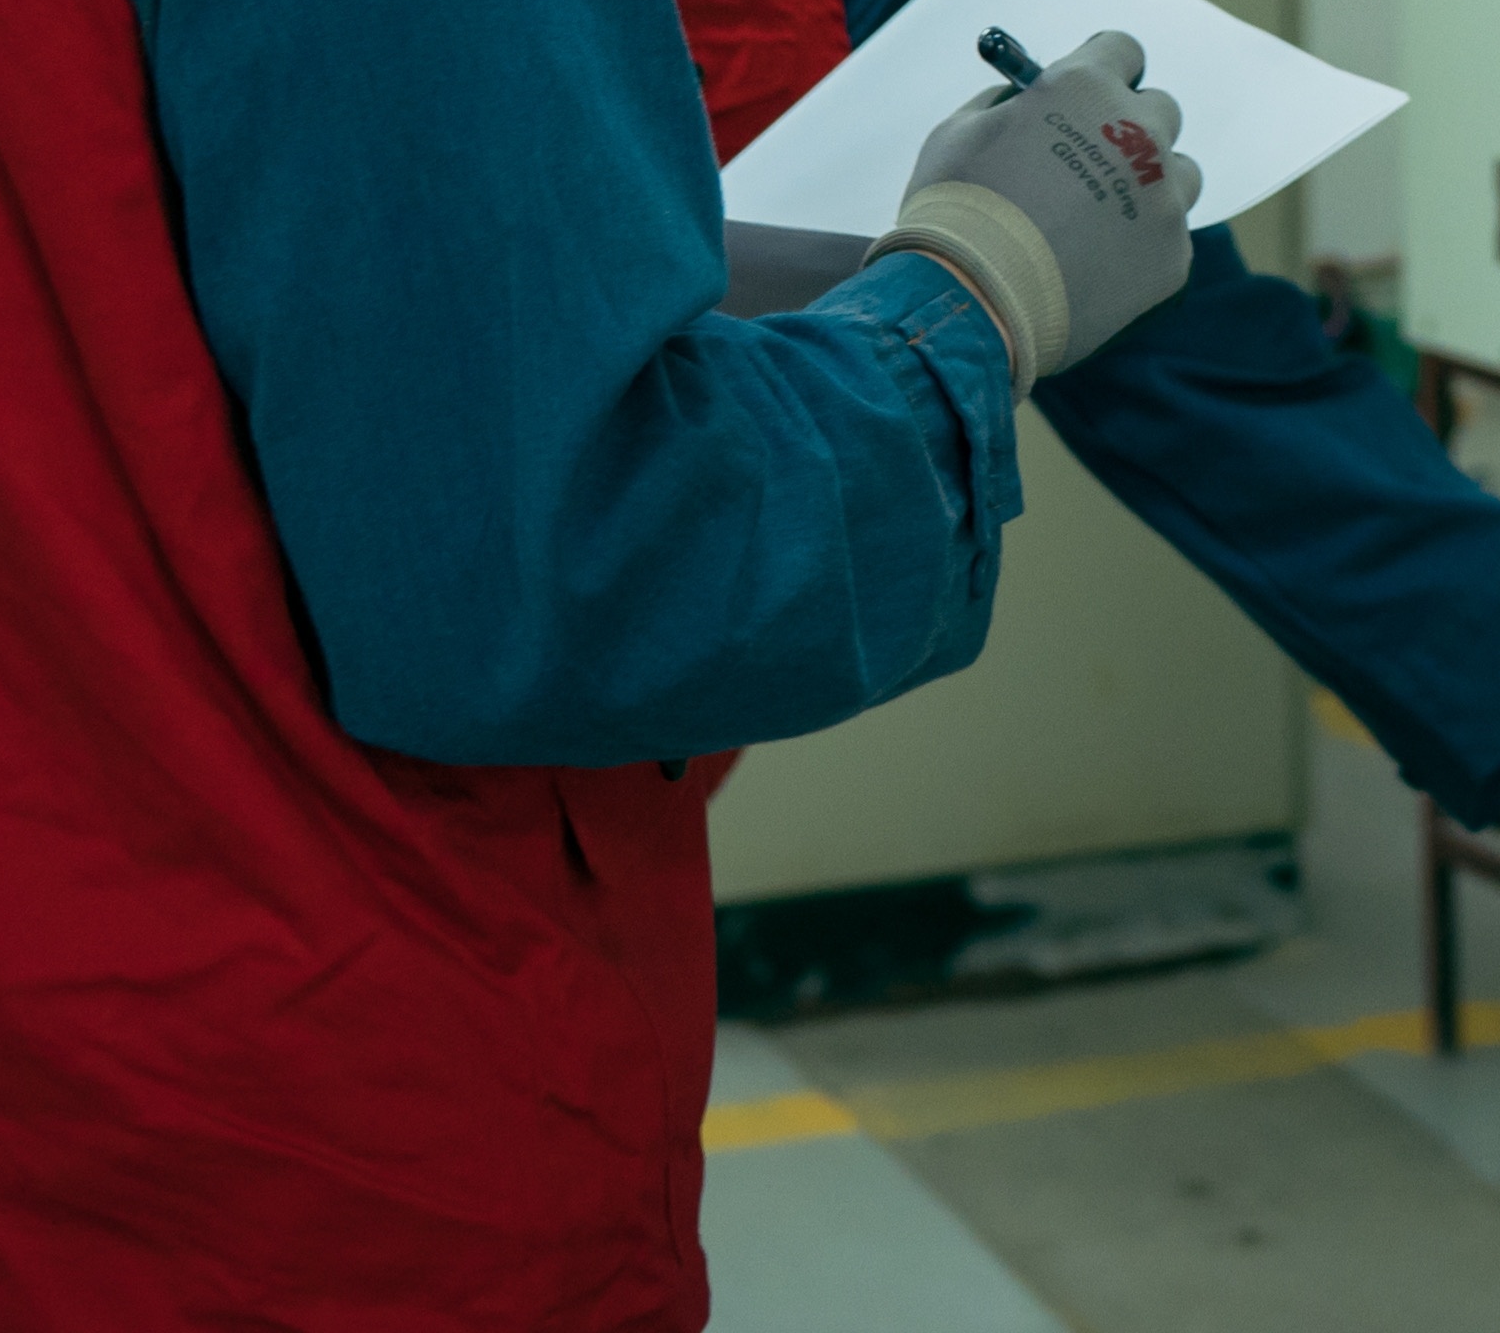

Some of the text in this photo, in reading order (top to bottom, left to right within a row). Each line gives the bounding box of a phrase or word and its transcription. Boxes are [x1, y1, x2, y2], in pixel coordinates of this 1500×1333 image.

[1043, 111, 1140, 222] Comfort Grip
[1050, 140, 1109, 203] Gloves
[1100, 118, 1166, 187] 3M
